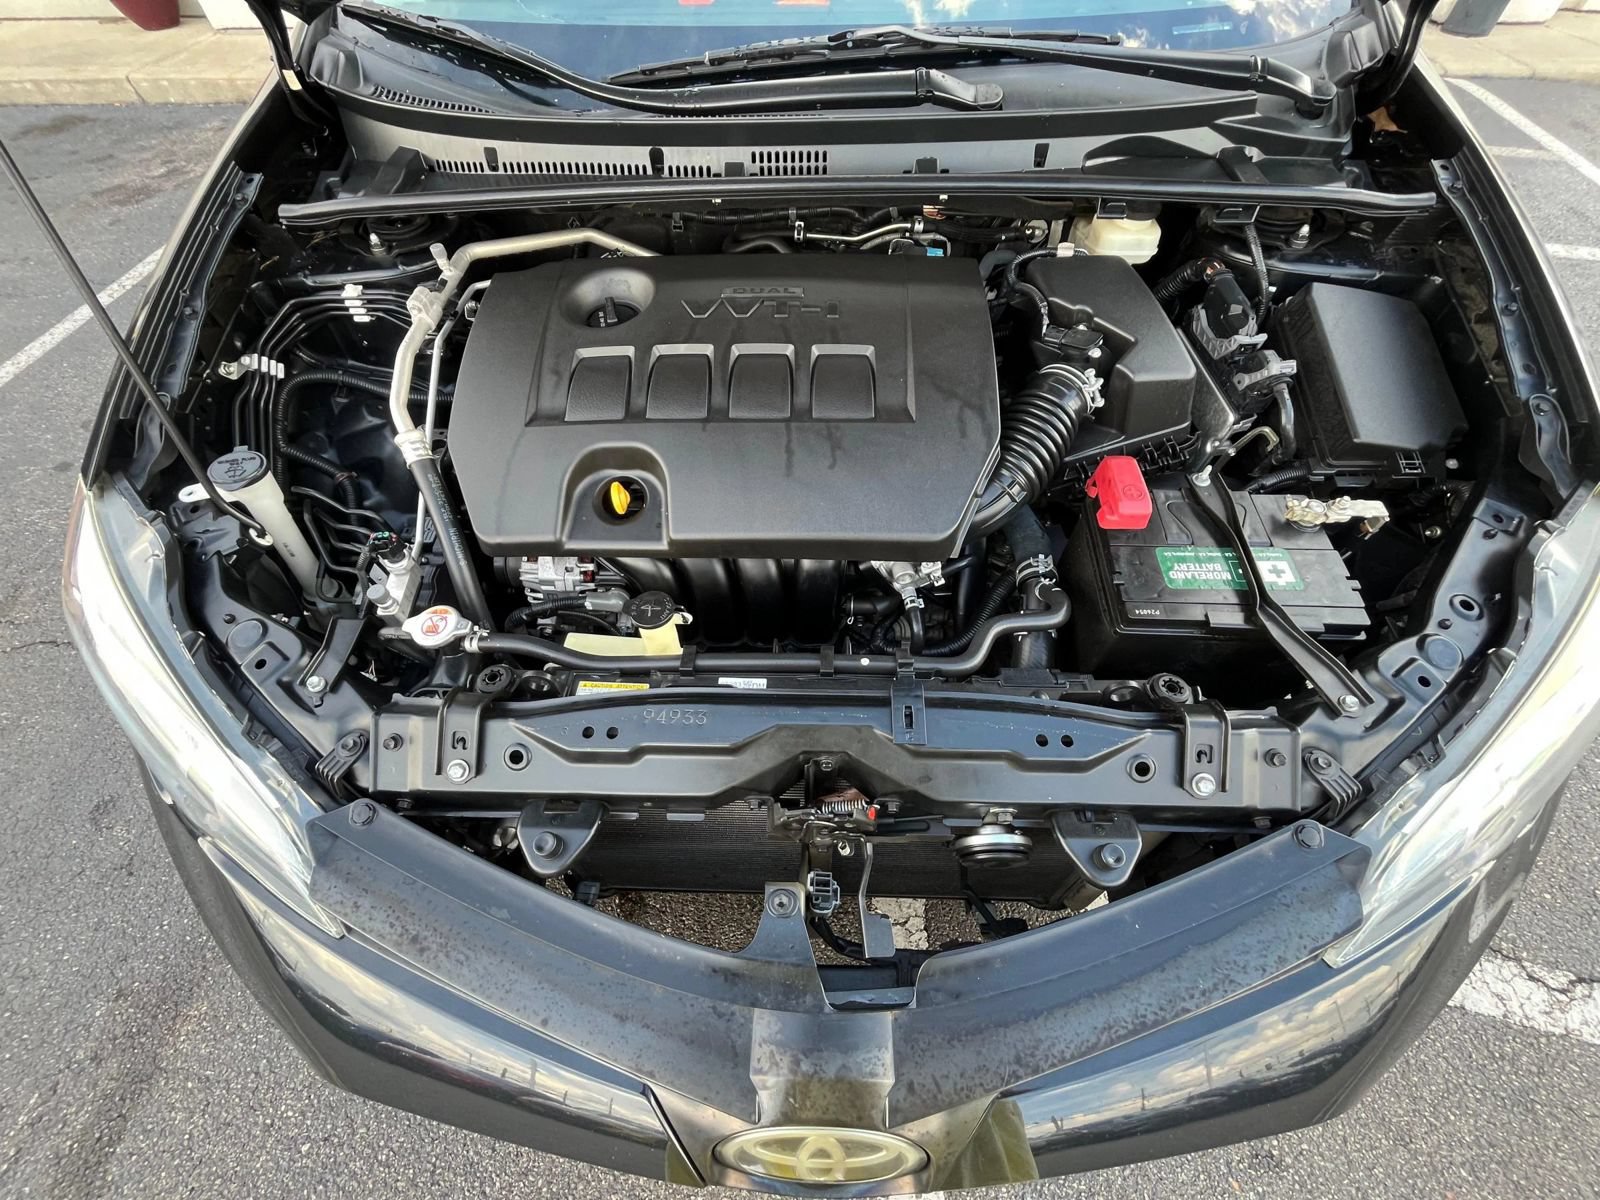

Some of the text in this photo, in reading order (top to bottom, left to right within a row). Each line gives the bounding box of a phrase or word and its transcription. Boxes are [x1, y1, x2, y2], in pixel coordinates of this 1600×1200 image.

[733, 287, 796, 295] DUAL
[1173, 562, 1221, 571] BATTERY
[1168, 570, 1232, 580] MORELAND
[643, 708, 708, 725] 94933
